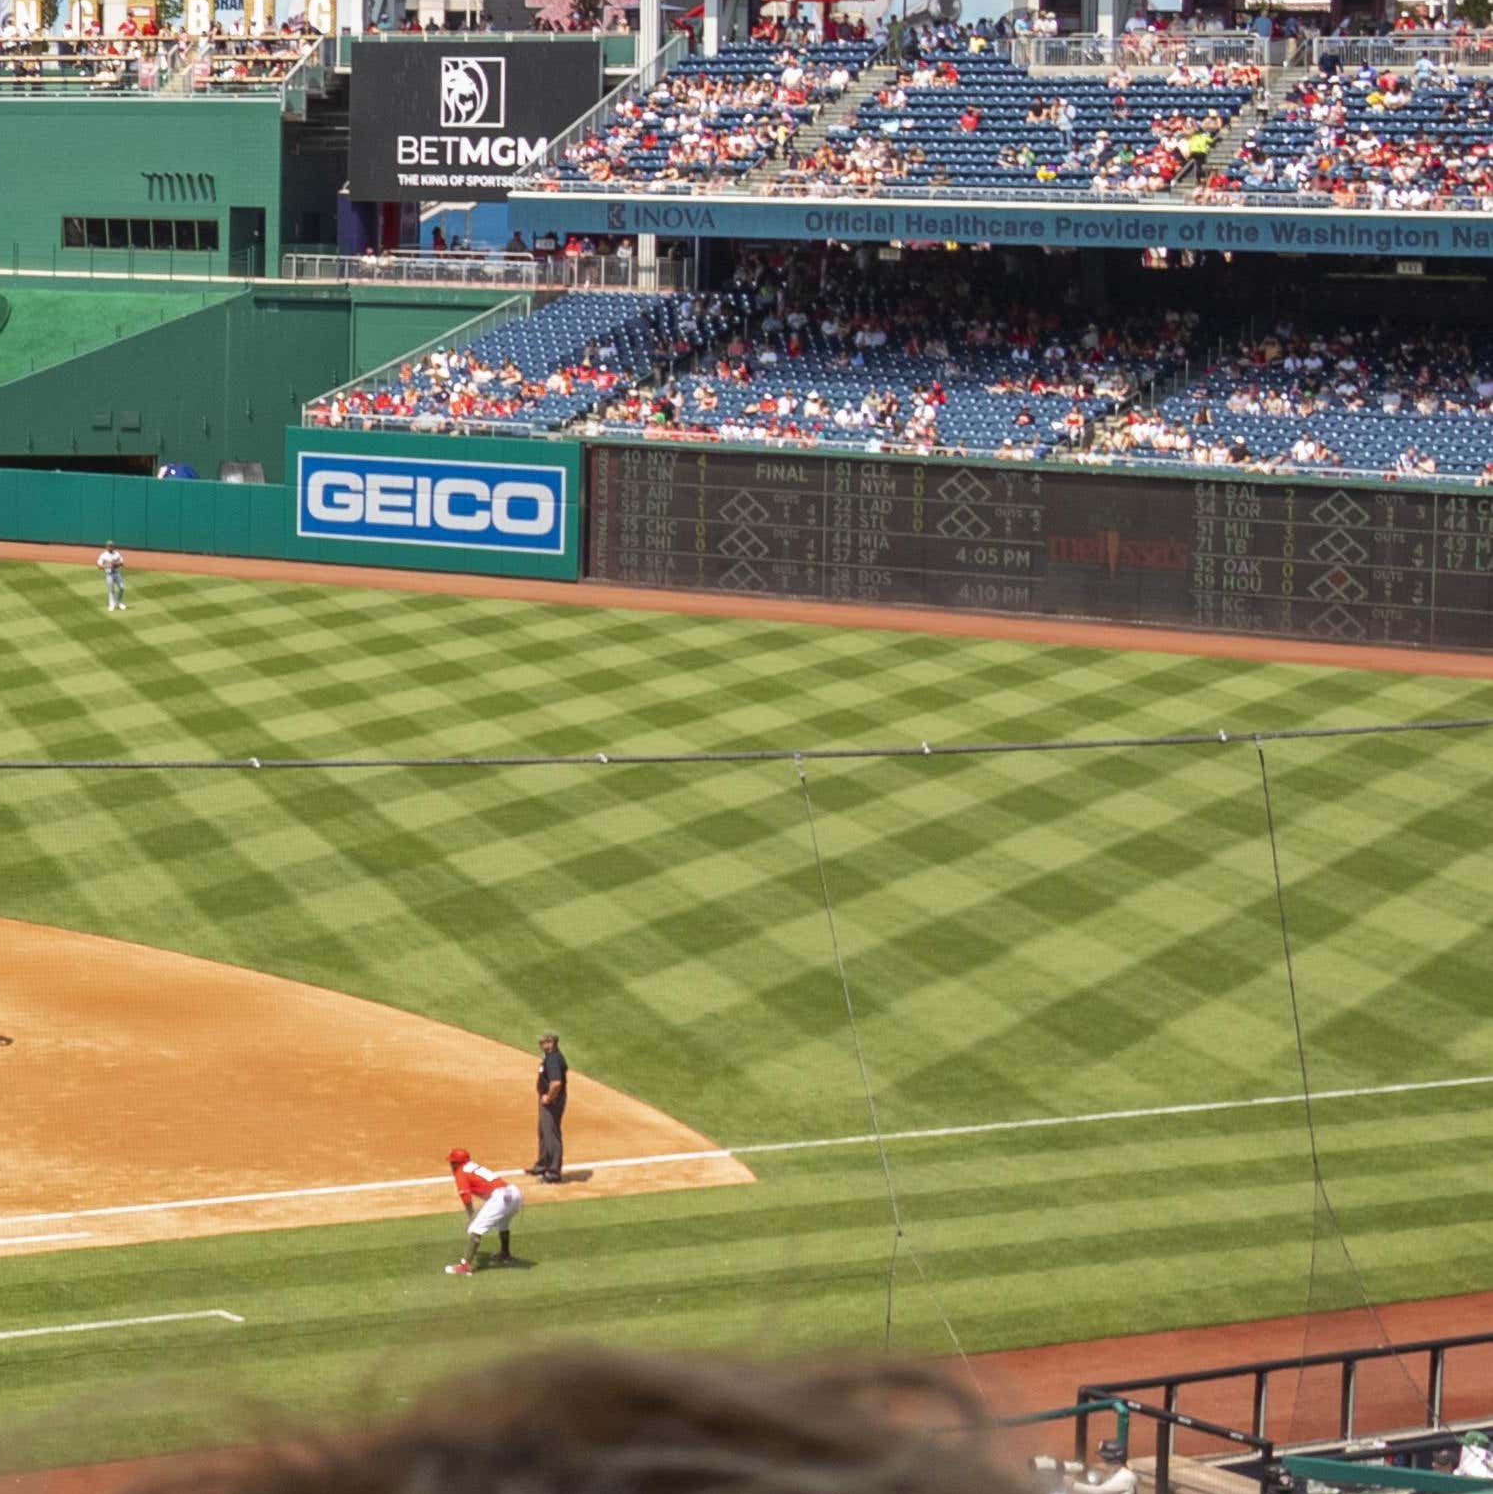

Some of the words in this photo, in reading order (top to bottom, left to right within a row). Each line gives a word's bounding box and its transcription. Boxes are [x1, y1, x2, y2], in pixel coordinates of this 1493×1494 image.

[397, 136, 547, 166] BETMGM
[397, 174, 418, 186] THE
[421, 174, 448, 186] KING
[634, 209, 716, 230] INOVA
[805, 210, 895, 234] Official
[905, 212, 1046, 238] Healthcare
[1055, 215, 1168, 241] Provider
[1178, 219, 1207, 241] of
[1217, 220, 1259, 243] the
[1270, 221, 1441, 253] Washington
[756, 462, 808, 484] FINAL
[307, 470, 555, 536] GEICO
[956, 547, 998, 565] 4:05
[1003, 550, 1031, 567] PM
